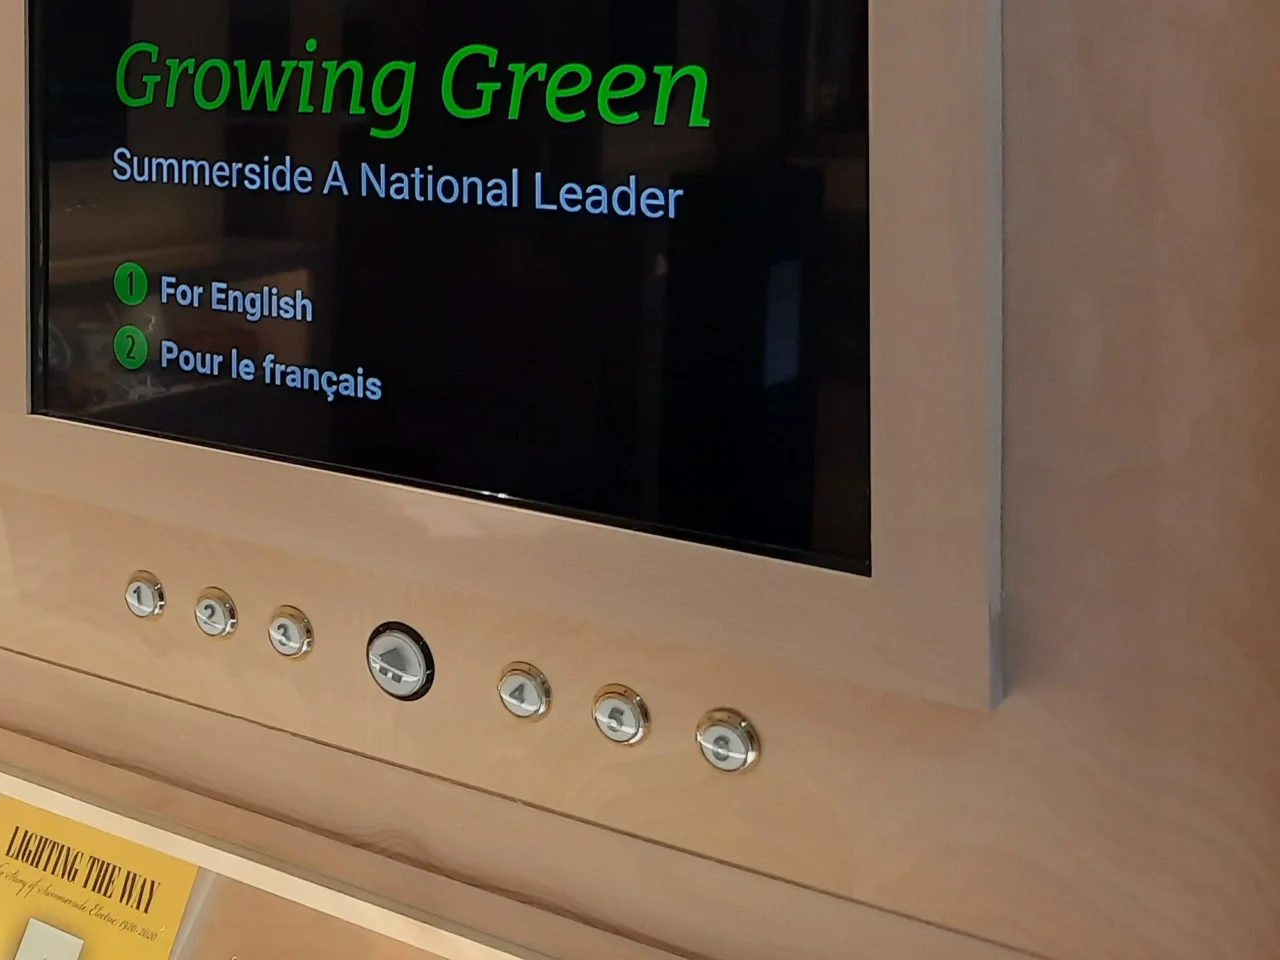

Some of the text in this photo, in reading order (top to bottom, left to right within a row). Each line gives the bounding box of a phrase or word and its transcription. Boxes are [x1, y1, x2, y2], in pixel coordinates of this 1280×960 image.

[116, 38, 710, 139] Growing Green
[112, 147, 684, 219] Summerside A National Leader
[126, 271, 313, 322] 1 For English
[125, 334, 382, 402] 2 Pour le français
[132, 585, 143, 606] 1
[203, 604, 217, 627] 2
[277, 623, 291, 647] 3
[508, 683, 525, 704] 4
[5, 825, 161, 914] LIGHTING THE WAY
[4, 871, 27, 896] Story
[24, 877, 39, 898] of
[36, 883, 88, 912] Summerside
[88, 903, 119, 925] Electric
